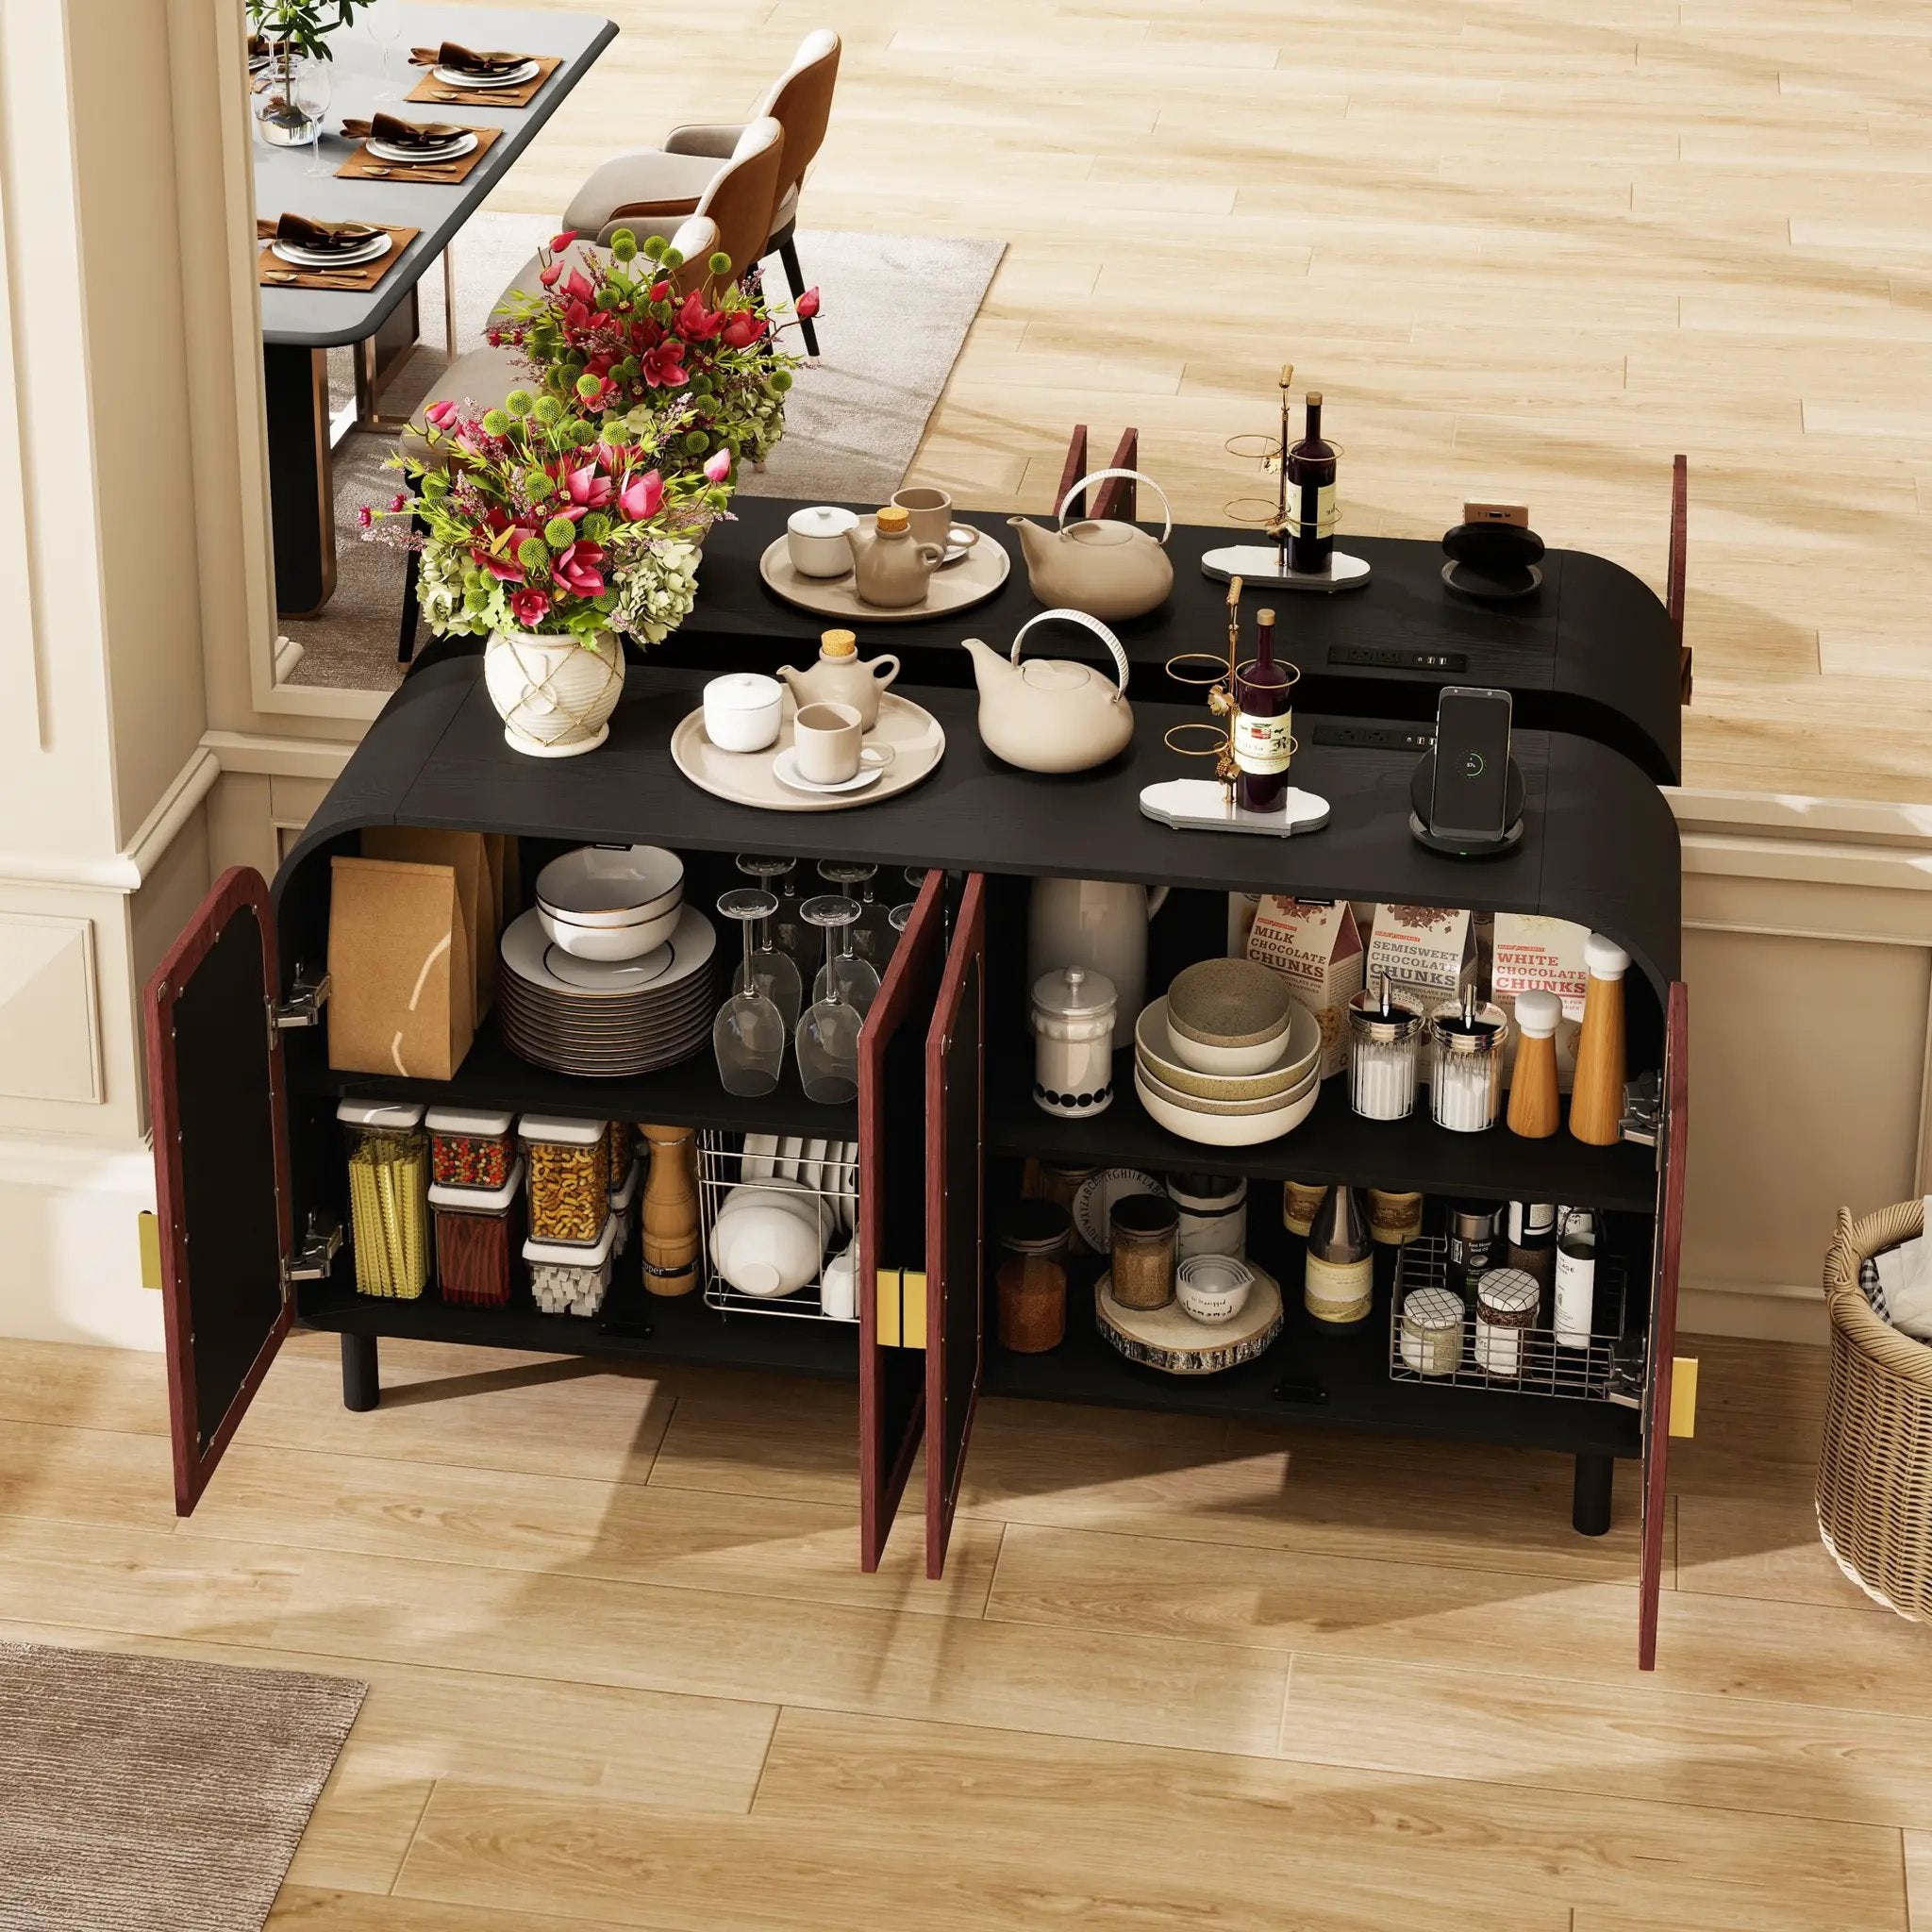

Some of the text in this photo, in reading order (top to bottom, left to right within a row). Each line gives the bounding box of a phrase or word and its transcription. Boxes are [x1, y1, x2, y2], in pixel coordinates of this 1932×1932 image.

[1254, 925, 1295, 944] MILK
[1251, 937, 1326, 965] CHOCOLATE
[1373, 941, 1458, 961] SEMISWEET
[1497, 953, 1558, 966] WHITE
[1249, 949, 1324, 978] CHUNKS
[1372, 952, 1457, 973] CHOCOLATE
[1370, 963, 1456, 987] CHUNKS
[1496, 965, 1586, 980] CHOCOLATE
[1496, 977, 1586, 993] CHUNKS
[642, 1259, 664, 1275] pper
